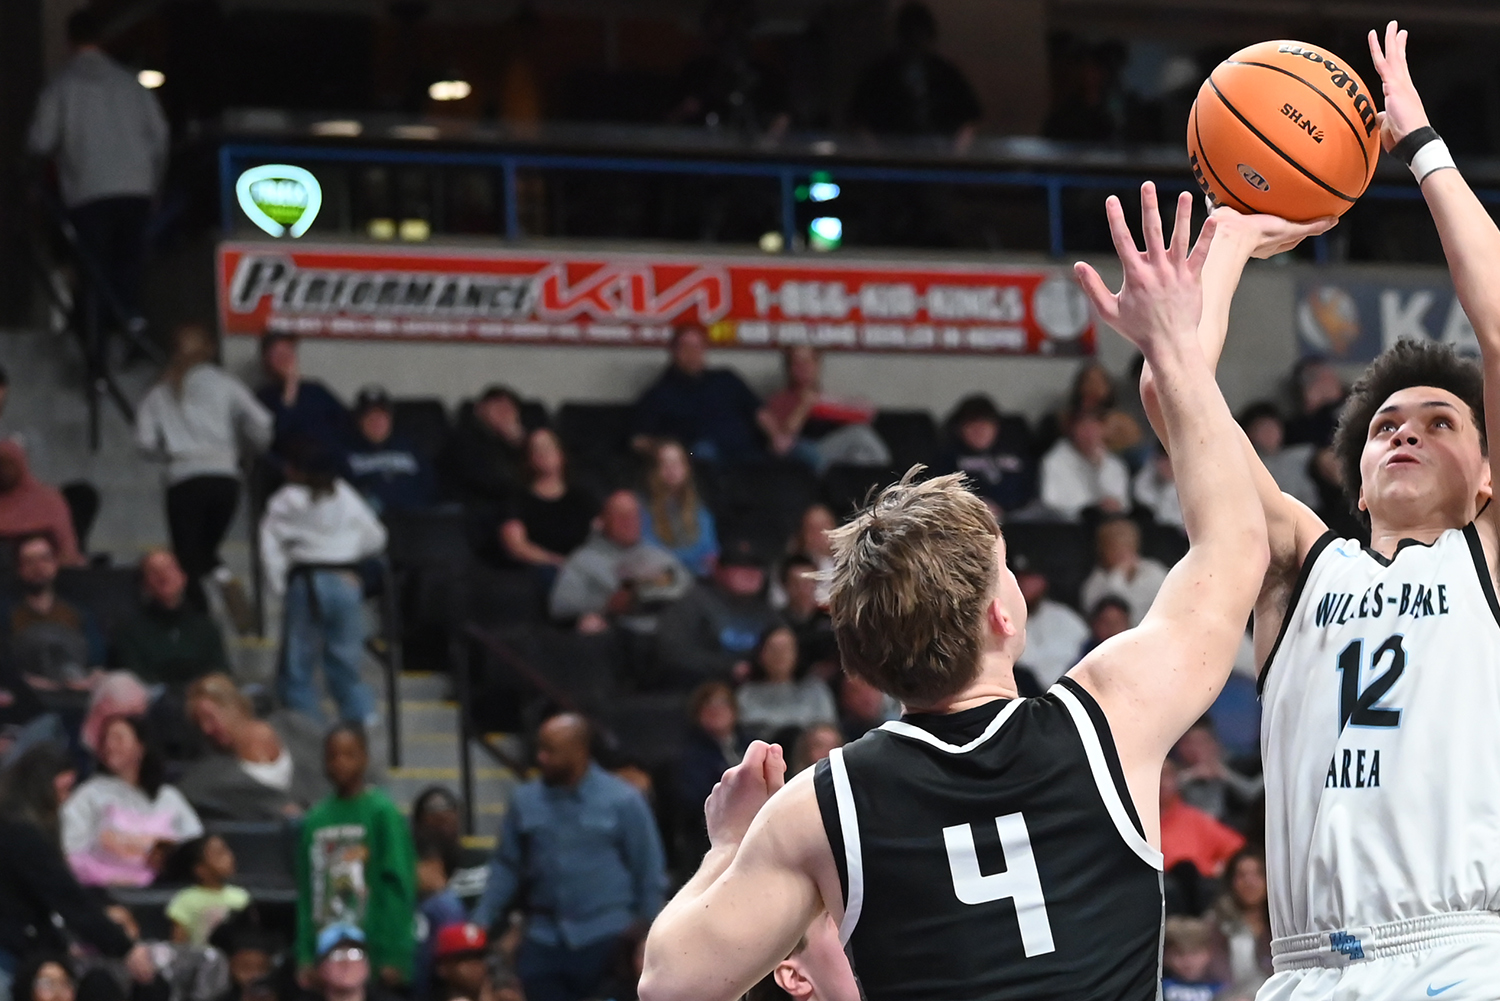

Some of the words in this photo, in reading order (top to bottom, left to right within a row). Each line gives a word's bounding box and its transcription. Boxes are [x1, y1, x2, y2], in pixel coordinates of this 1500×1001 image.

[1278, 44, 1376, 138] Wilson
[1280, 103, 1318, 136] NFHS
[540, 264, 730, 323] KIA
[1336, 633, 1408, 738] 12
[1325, 749, 1381, 789] AREA
[942, 811, 1056, 959] 4
